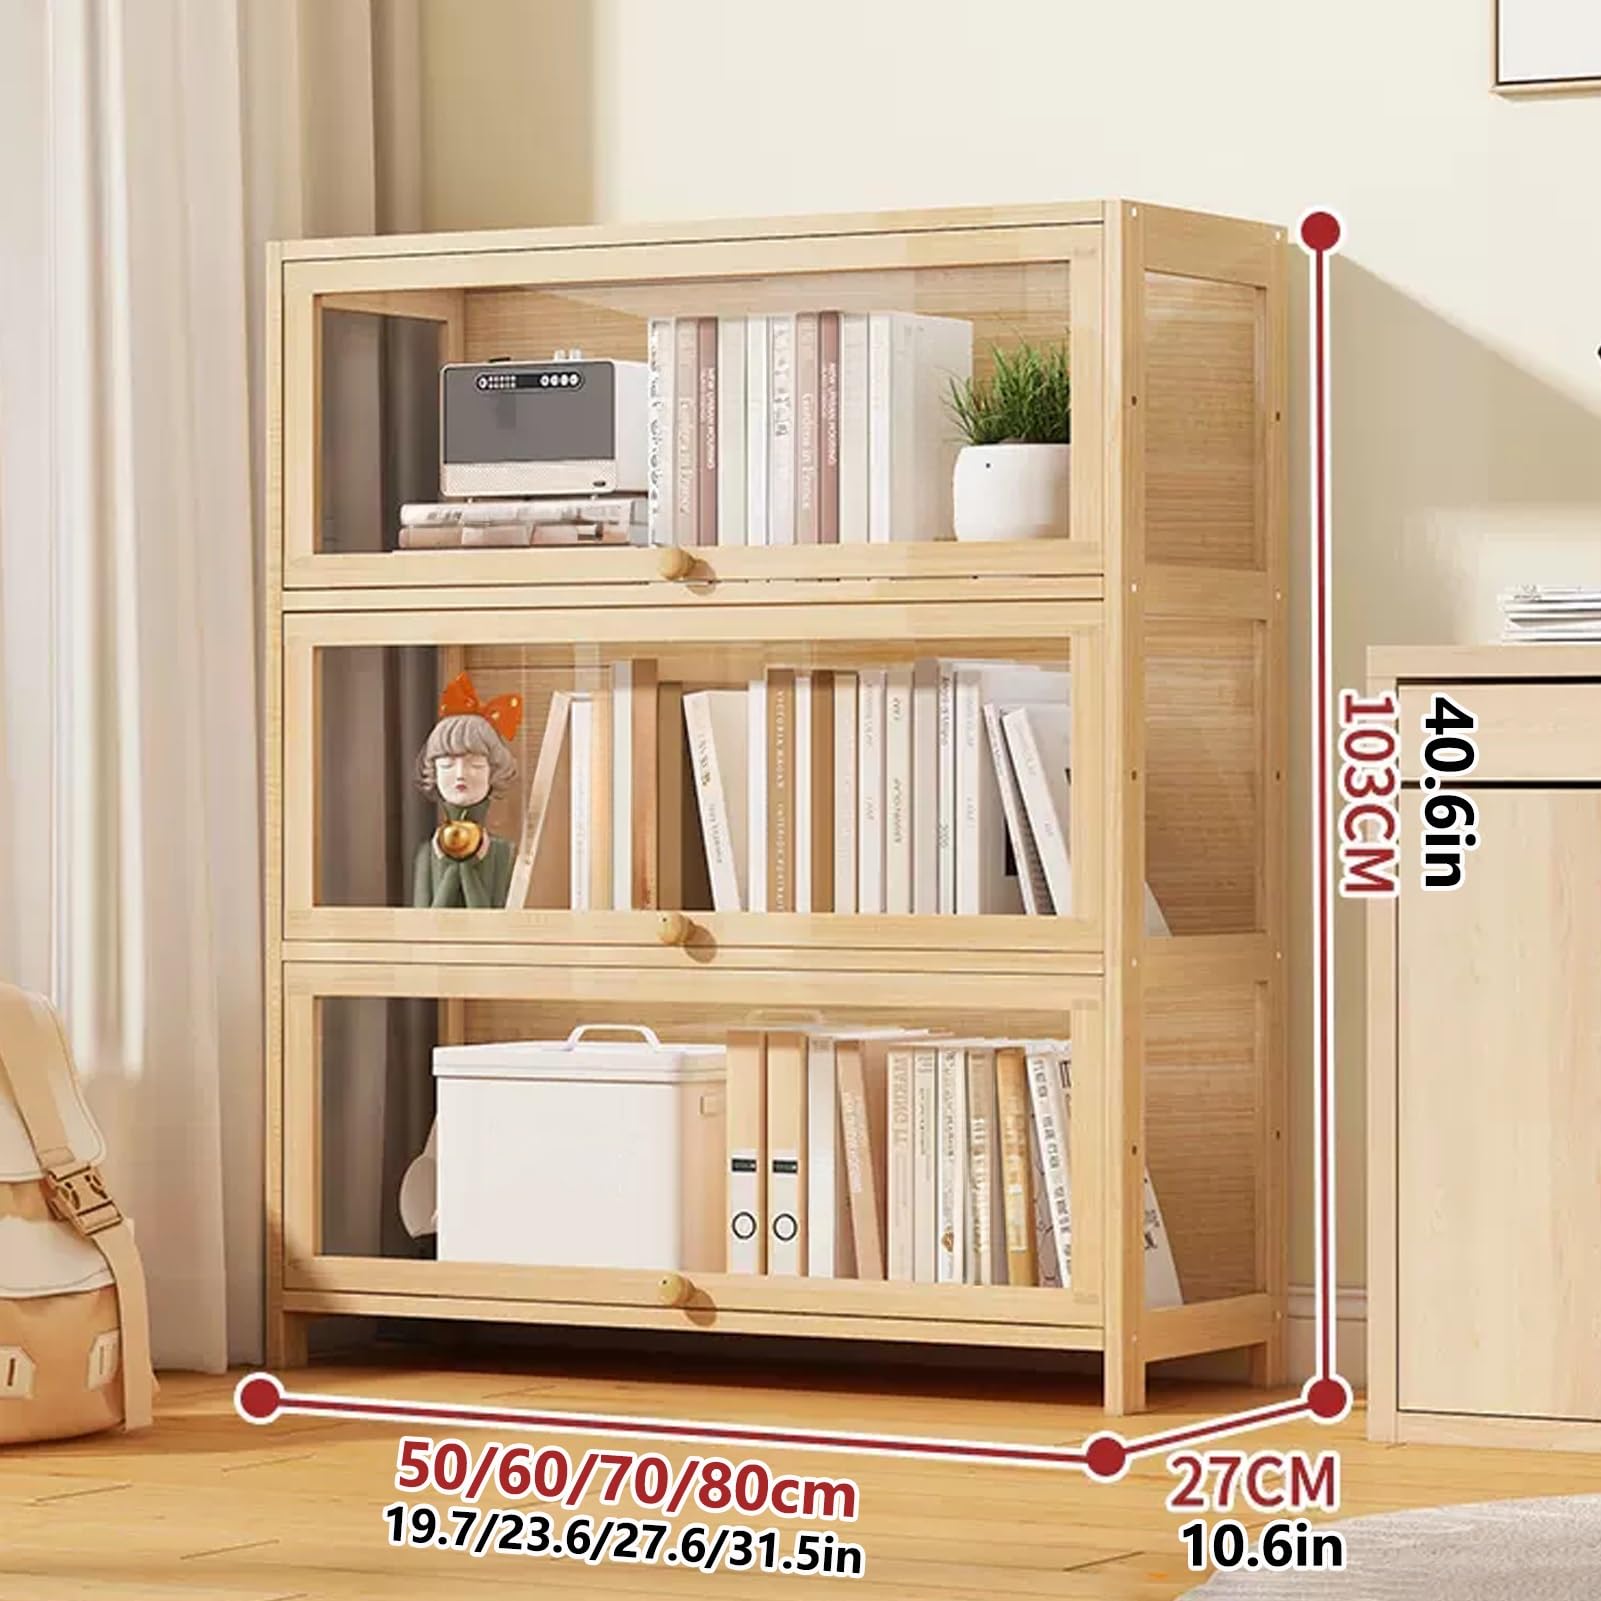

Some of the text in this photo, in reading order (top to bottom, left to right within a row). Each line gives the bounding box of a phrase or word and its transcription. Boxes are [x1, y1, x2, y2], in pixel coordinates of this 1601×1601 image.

[827, 362, 838, 465] NEW URBAN HOUSING
[775, 689, 785, 747] VICTORIA
